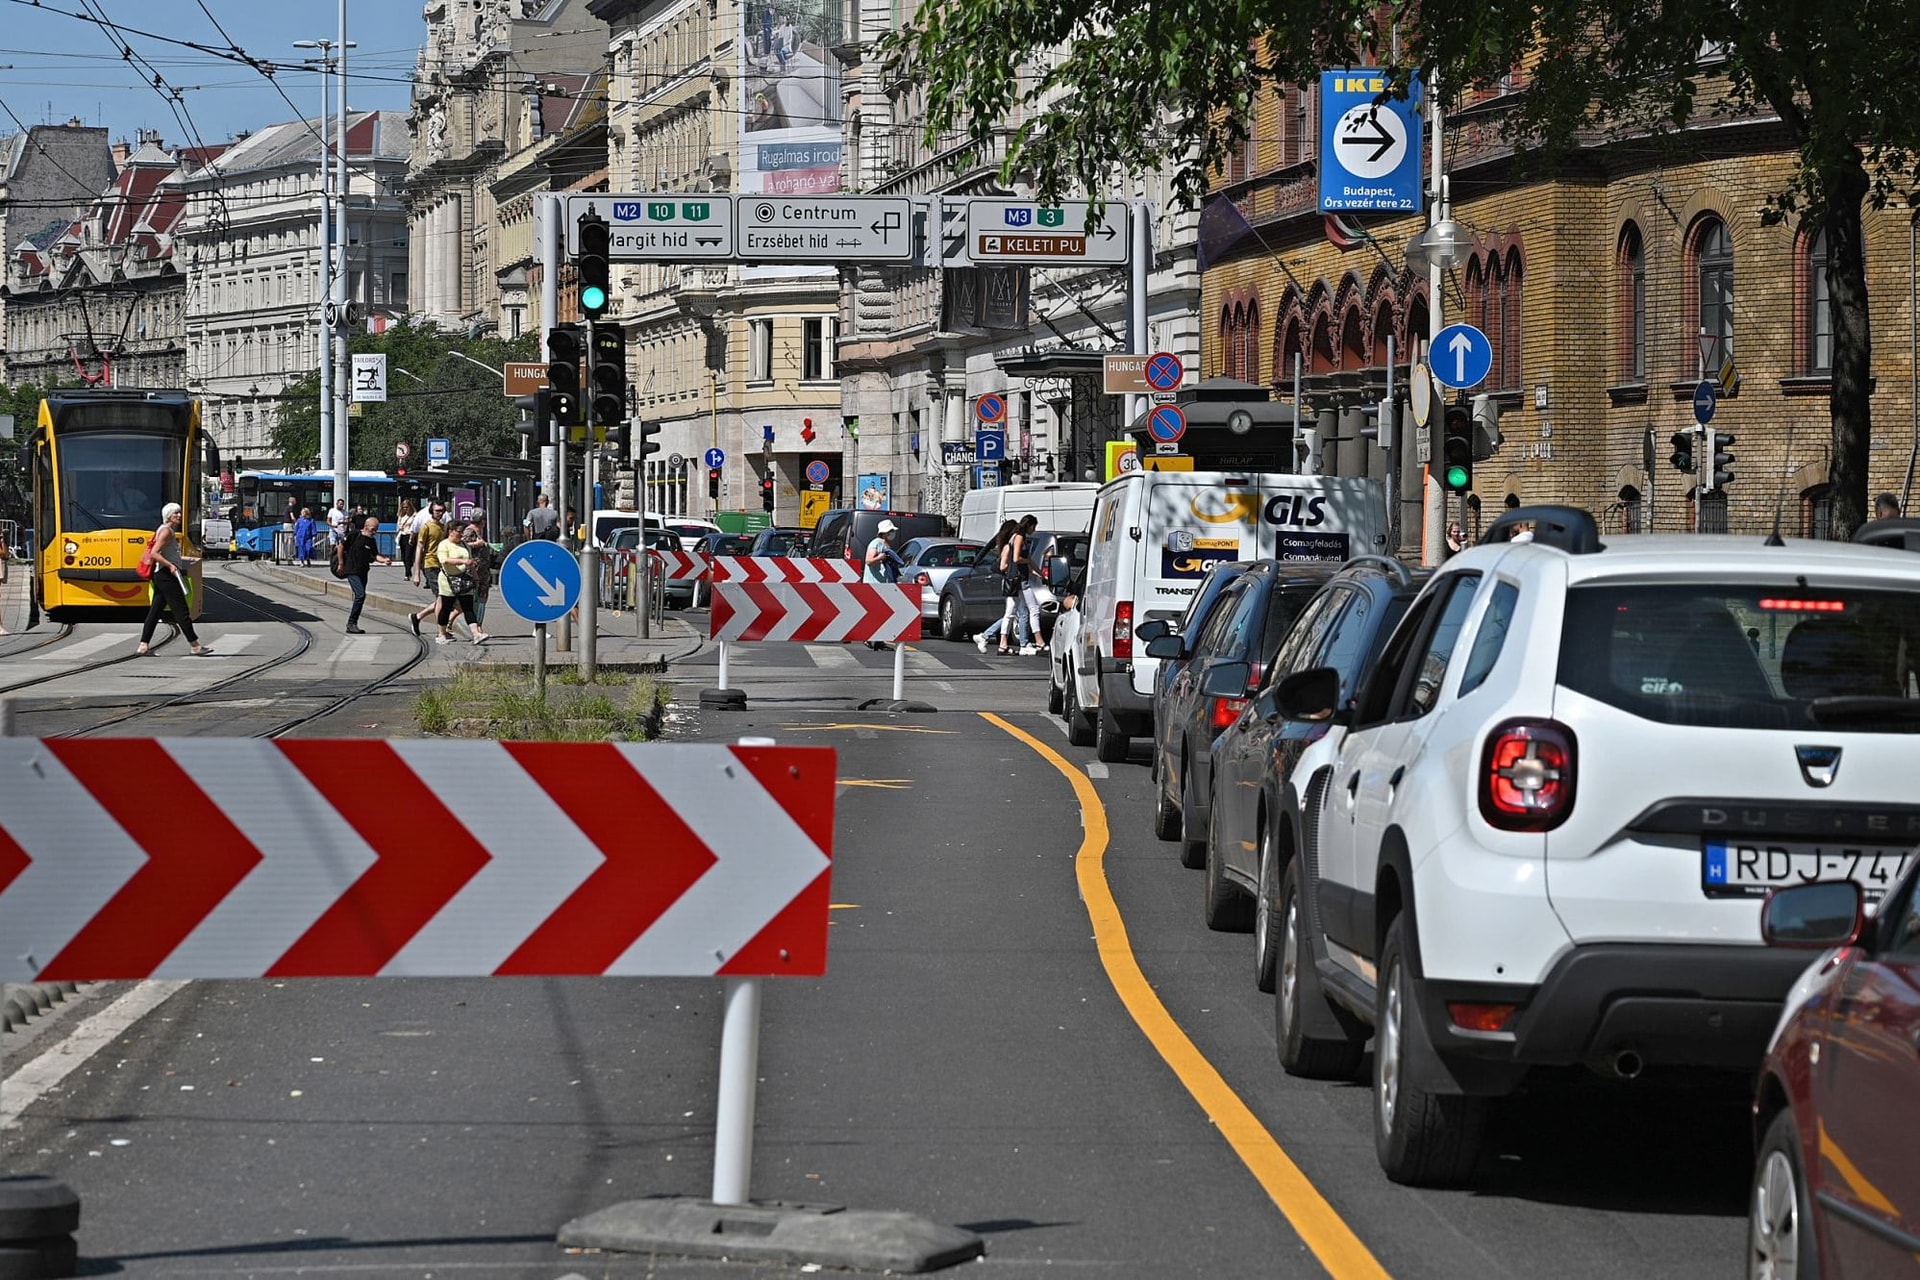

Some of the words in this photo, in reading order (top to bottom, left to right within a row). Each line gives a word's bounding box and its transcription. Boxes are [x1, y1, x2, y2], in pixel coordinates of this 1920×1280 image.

[762, 148, 810, 168] Rugalmas
[813, 147, 840, 163] irod
[775, 173, 816, 191] rohanó
[1343, 186, 1396, 198] Budapest,
[1324, 197, 1343, 208] Őrs
[1345, 198, 1374, 208] vezér
[1376, 199, 1398, 208] tere
[1400, 199, 1414, 208] 22.
[616, 204, 637, 218] M2
[655, 204, 668, 218] 10
[690, 204, 701, 218] 11
[782, 205, 857, 220] Centrum
[1008, 210, 1028, 223] M3
[1045, 211, 1055, 223] 3
[748, 233, 804, 248] Erzsébet
[1007, 239, 1054, 251] KELETI
[1060, 240, 1082, 252] PU.
[983, 440, 997, 457] P
[1264, 495, 1327, 527] GLS
[1282, 538, 1342, 550] Csomagfeladás
[84, 556, 112, 566] 2009
[1709, 864, 1722, 877] H
